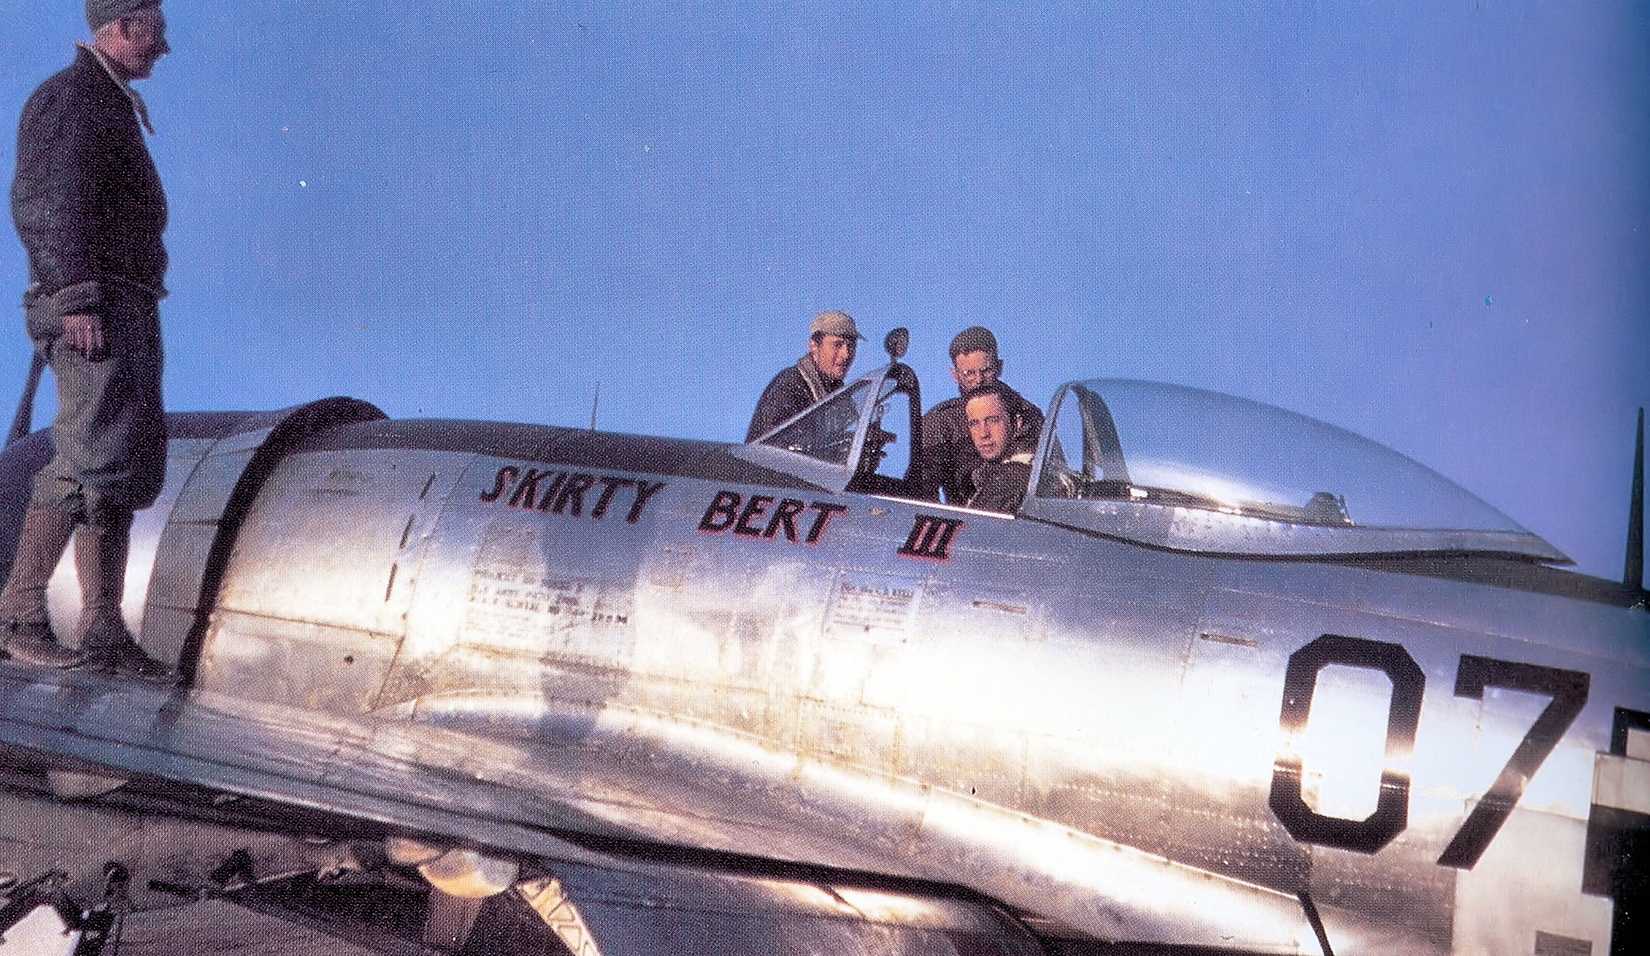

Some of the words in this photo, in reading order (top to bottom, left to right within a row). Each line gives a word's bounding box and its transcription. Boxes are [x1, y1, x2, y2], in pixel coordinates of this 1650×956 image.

[480, 465, 667, 525] SKIRTY
[698, 490, 849, 547] BERT
[897, 513, 966, 562] III
